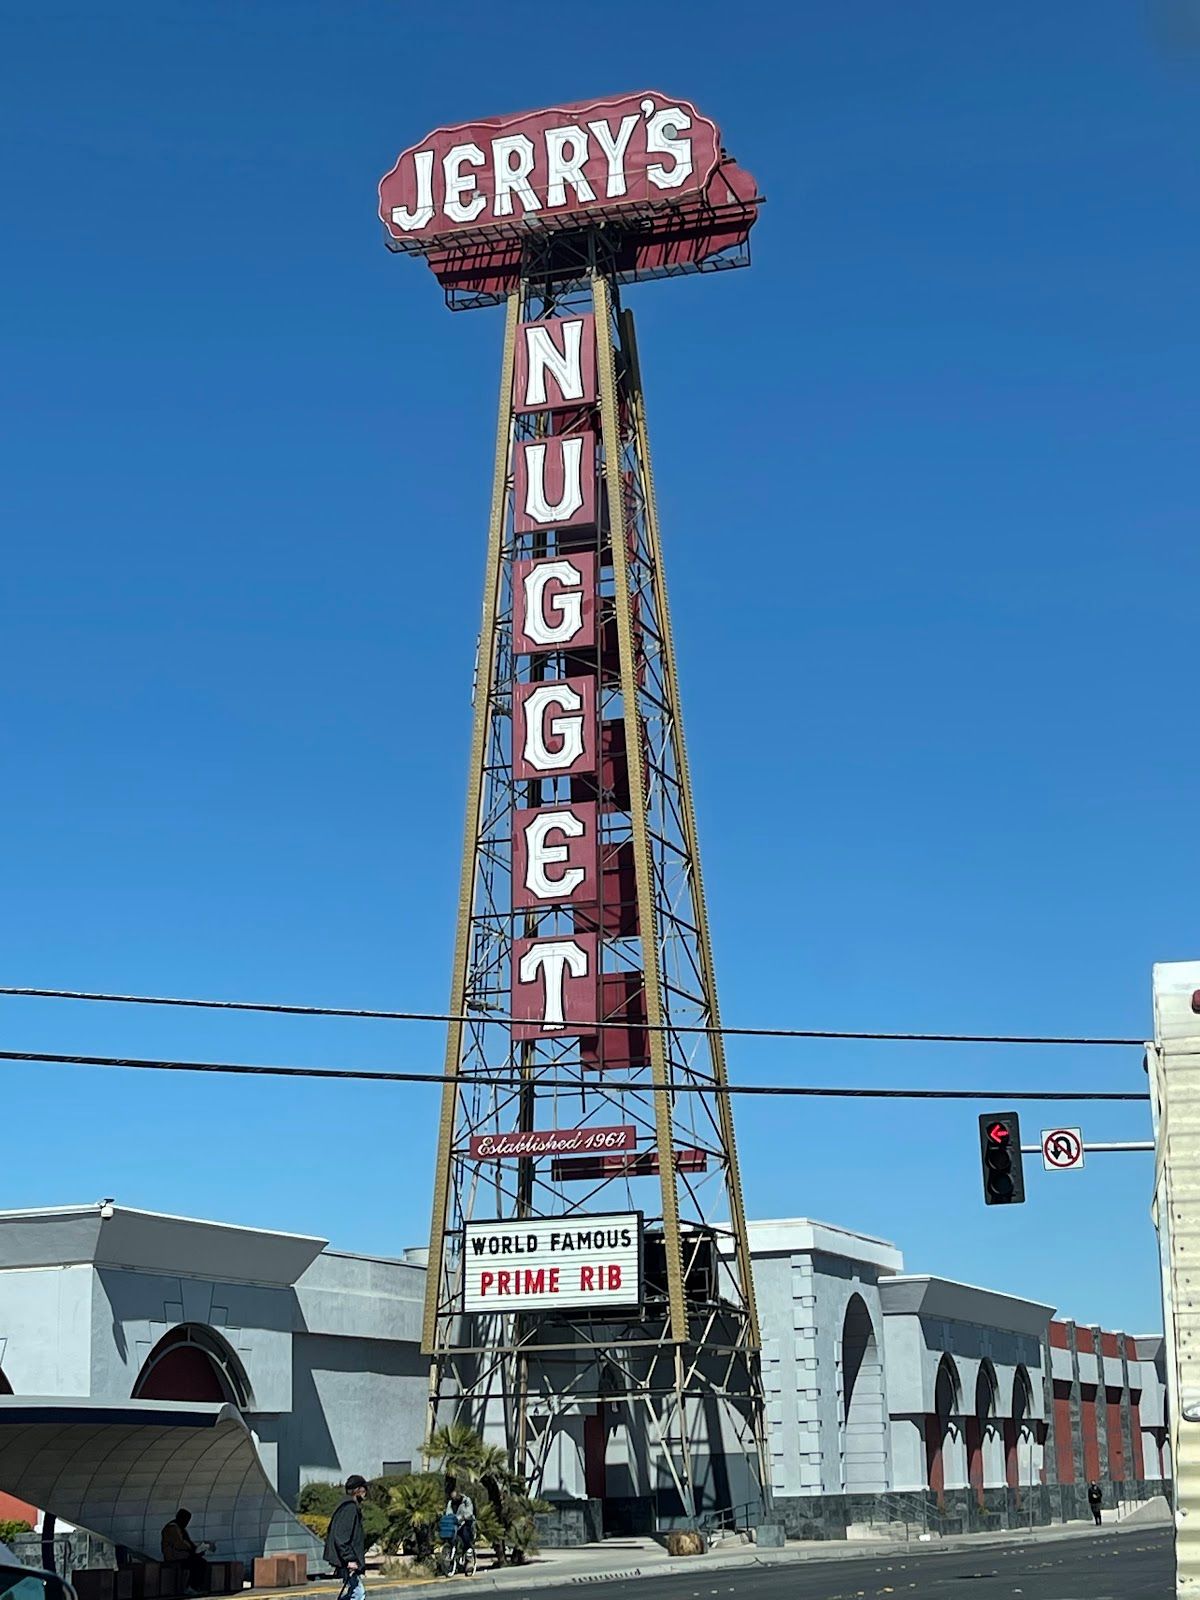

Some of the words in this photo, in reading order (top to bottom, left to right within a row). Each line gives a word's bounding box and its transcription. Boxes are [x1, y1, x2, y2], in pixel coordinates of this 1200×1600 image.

[391, 98, 693, 231] JERRY'S
[519, 320, 589, 1029] NUGGET
[478, 1132, 582, 1156] Established
[590, 1131, 626, 1148] 1964
[472, 1235, 538, 1256] WORLD
[551, 1230, 632, 1251] FAMOUS
[480, 1267, 560, 1296] PRIME
[580, 1265, 622, 1291] RIB
